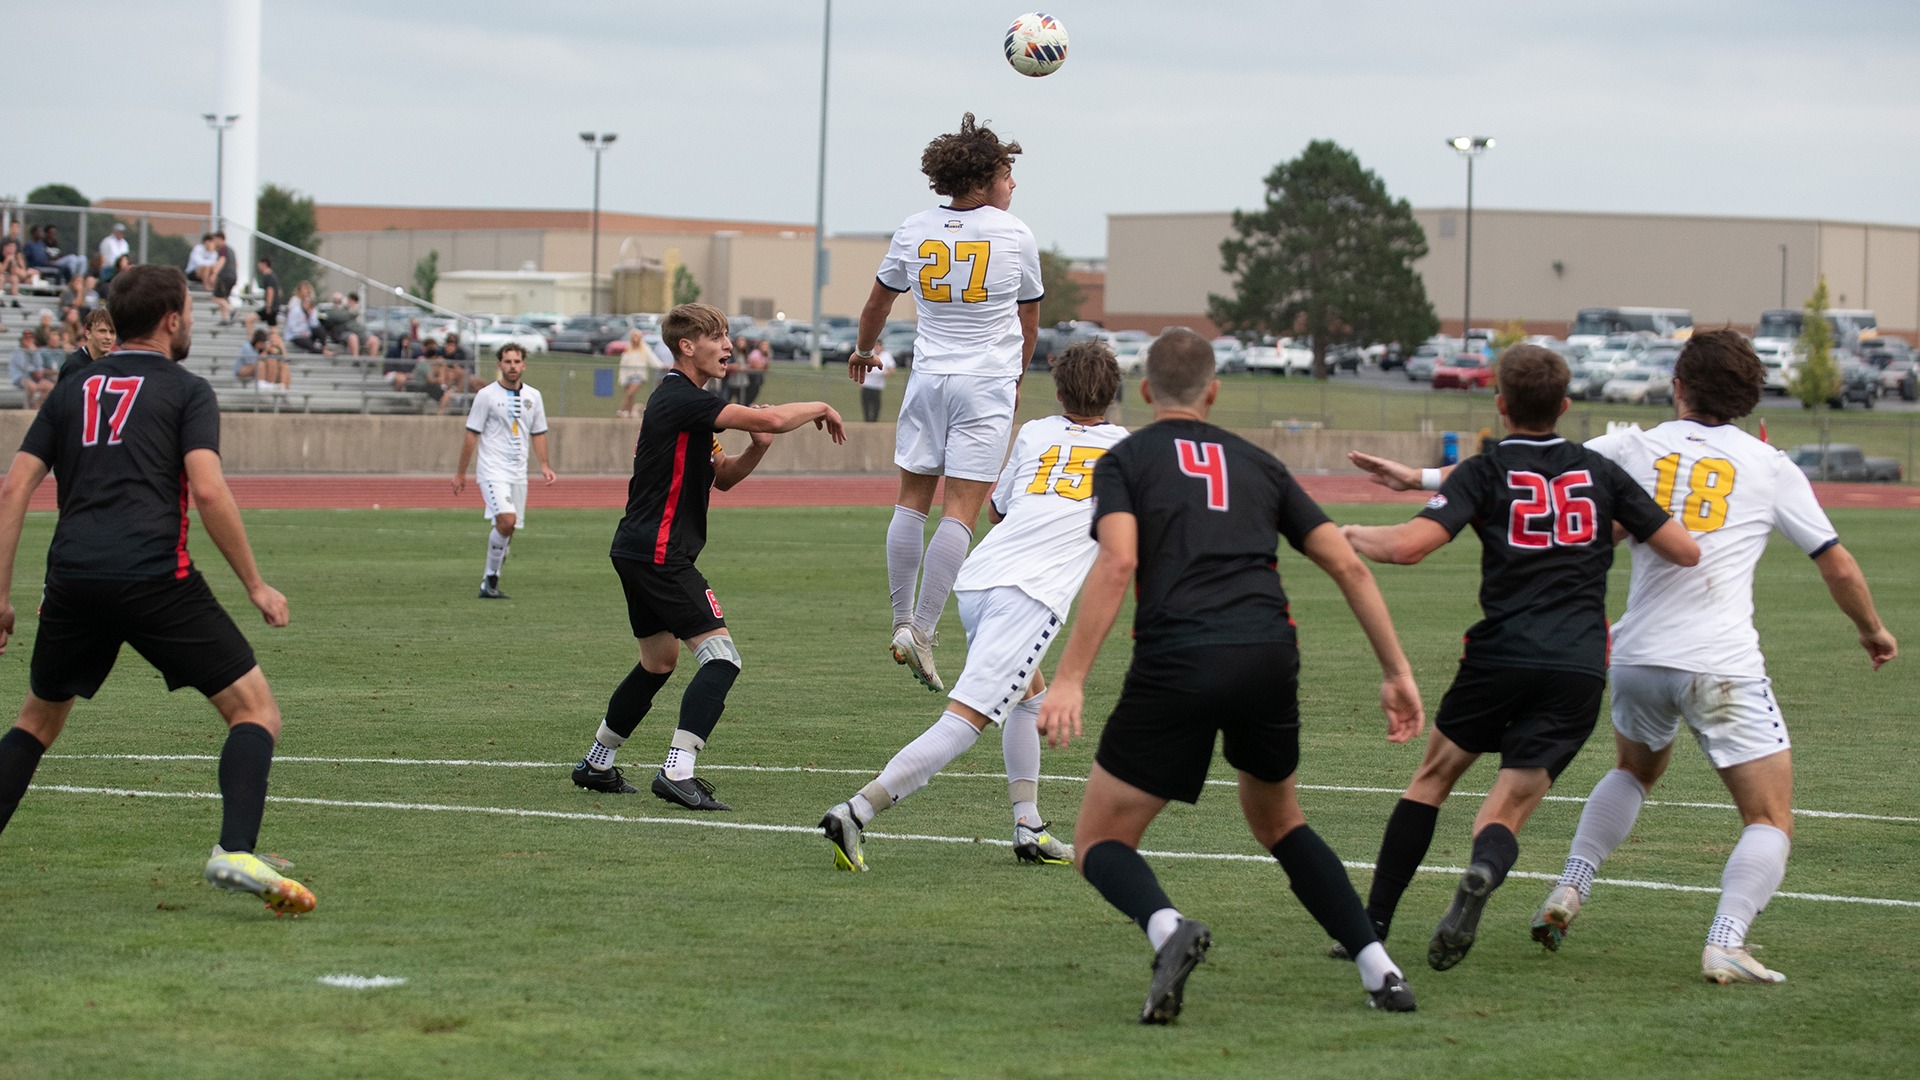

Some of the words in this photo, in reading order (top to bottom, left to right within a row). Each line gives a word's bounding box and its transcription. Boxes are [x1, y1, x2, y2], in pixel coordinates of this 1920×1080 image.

[918, 239, 991, 303] 27
[82, 374, 145, 447] 17
[1025, 445, 1109, 502] 15
[1173, 438, 1230, 512] 4
[1507, 469, 1598, 549] 26
[1653, 452, 1737, 533] 18
